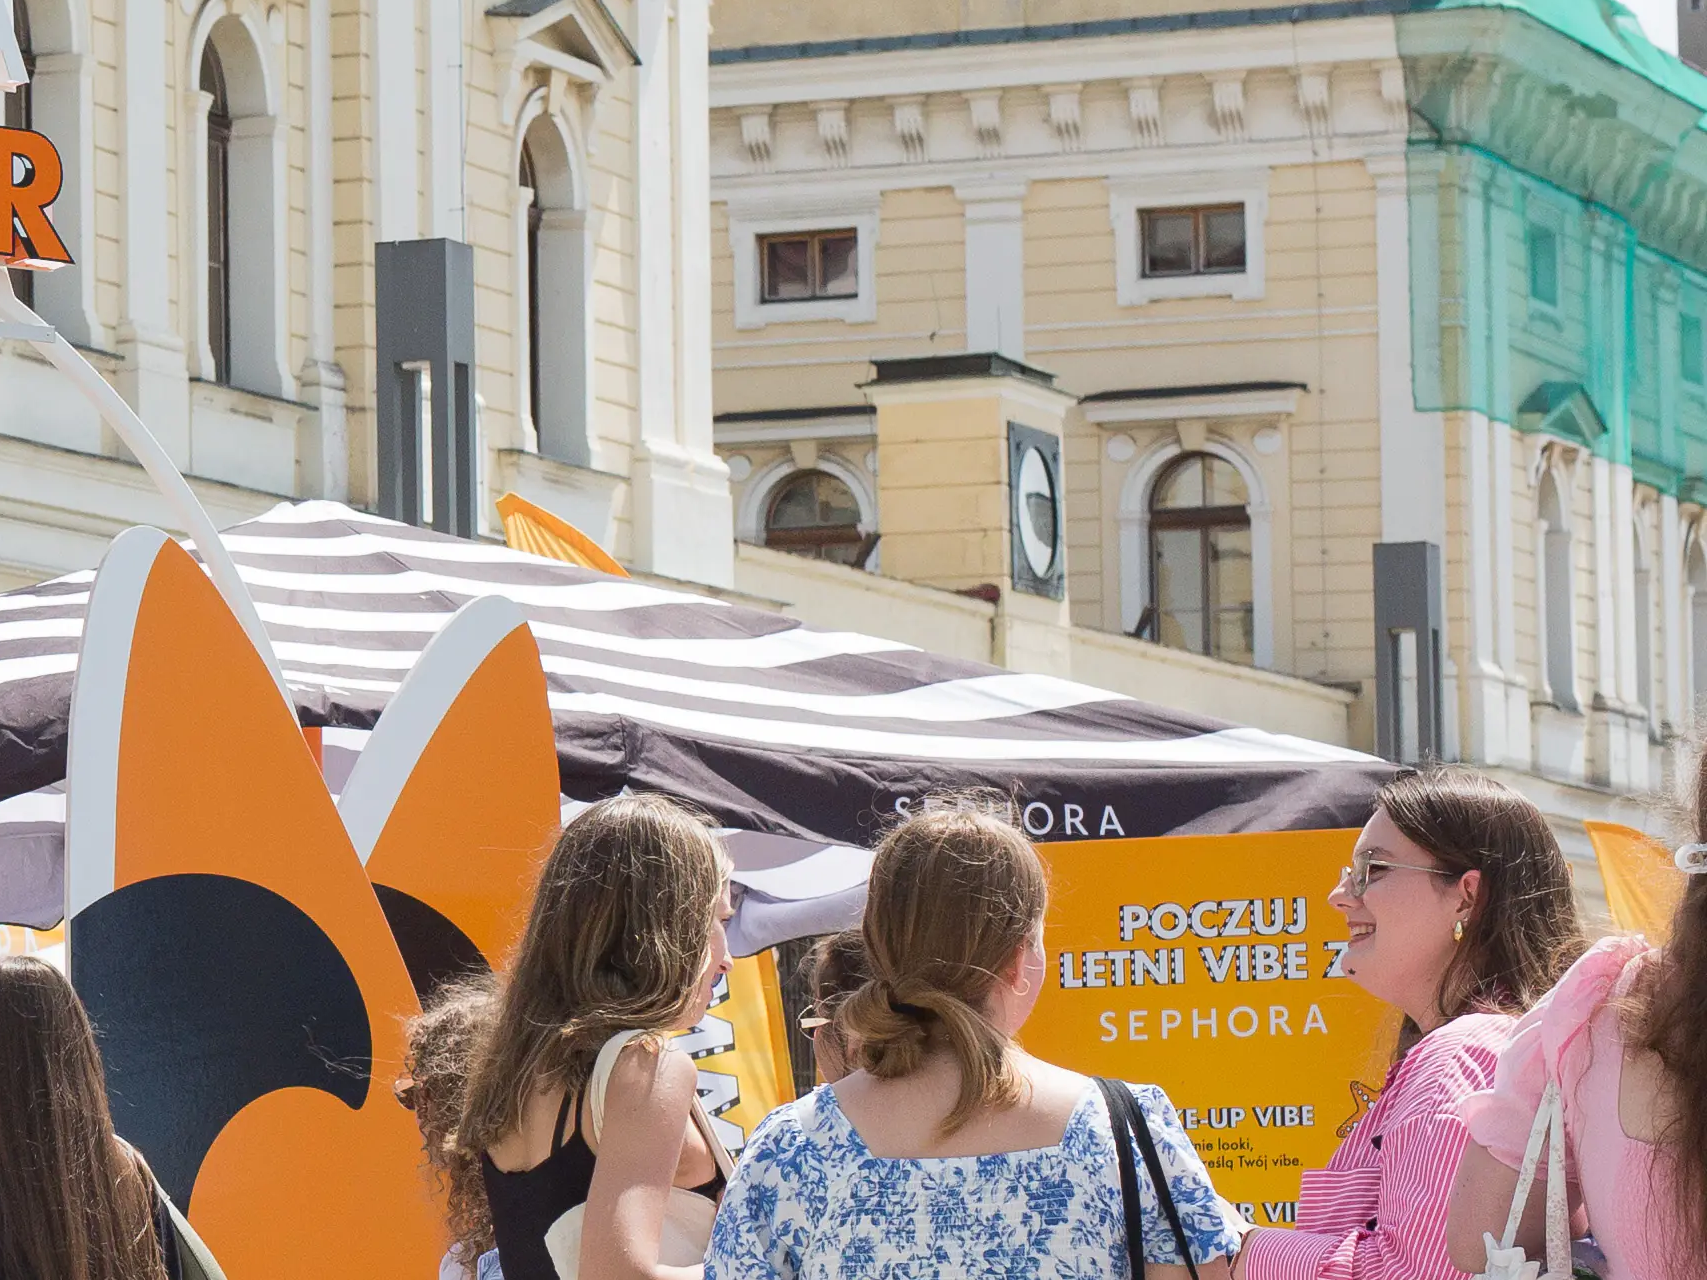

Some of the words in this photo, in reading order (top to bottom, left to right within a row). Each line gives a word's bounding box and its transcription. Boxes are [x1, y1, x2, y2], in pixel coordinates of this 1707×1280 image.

[1119, 896, 1308, 942] POCZUJ
[1059, 947, 1186, 989] LETNI
[1198, 942, 1308, 983] VIBE
[1099, 1004, 1329, 1043] SEPHORA
[1252, 1105, 1315, 1128] VIBE
[1218, 1137, 1254, 1152] looki,
[1238, 1155, 1269, 1171] Twój
[1272, 1152, 1304, 1167] vibe.
